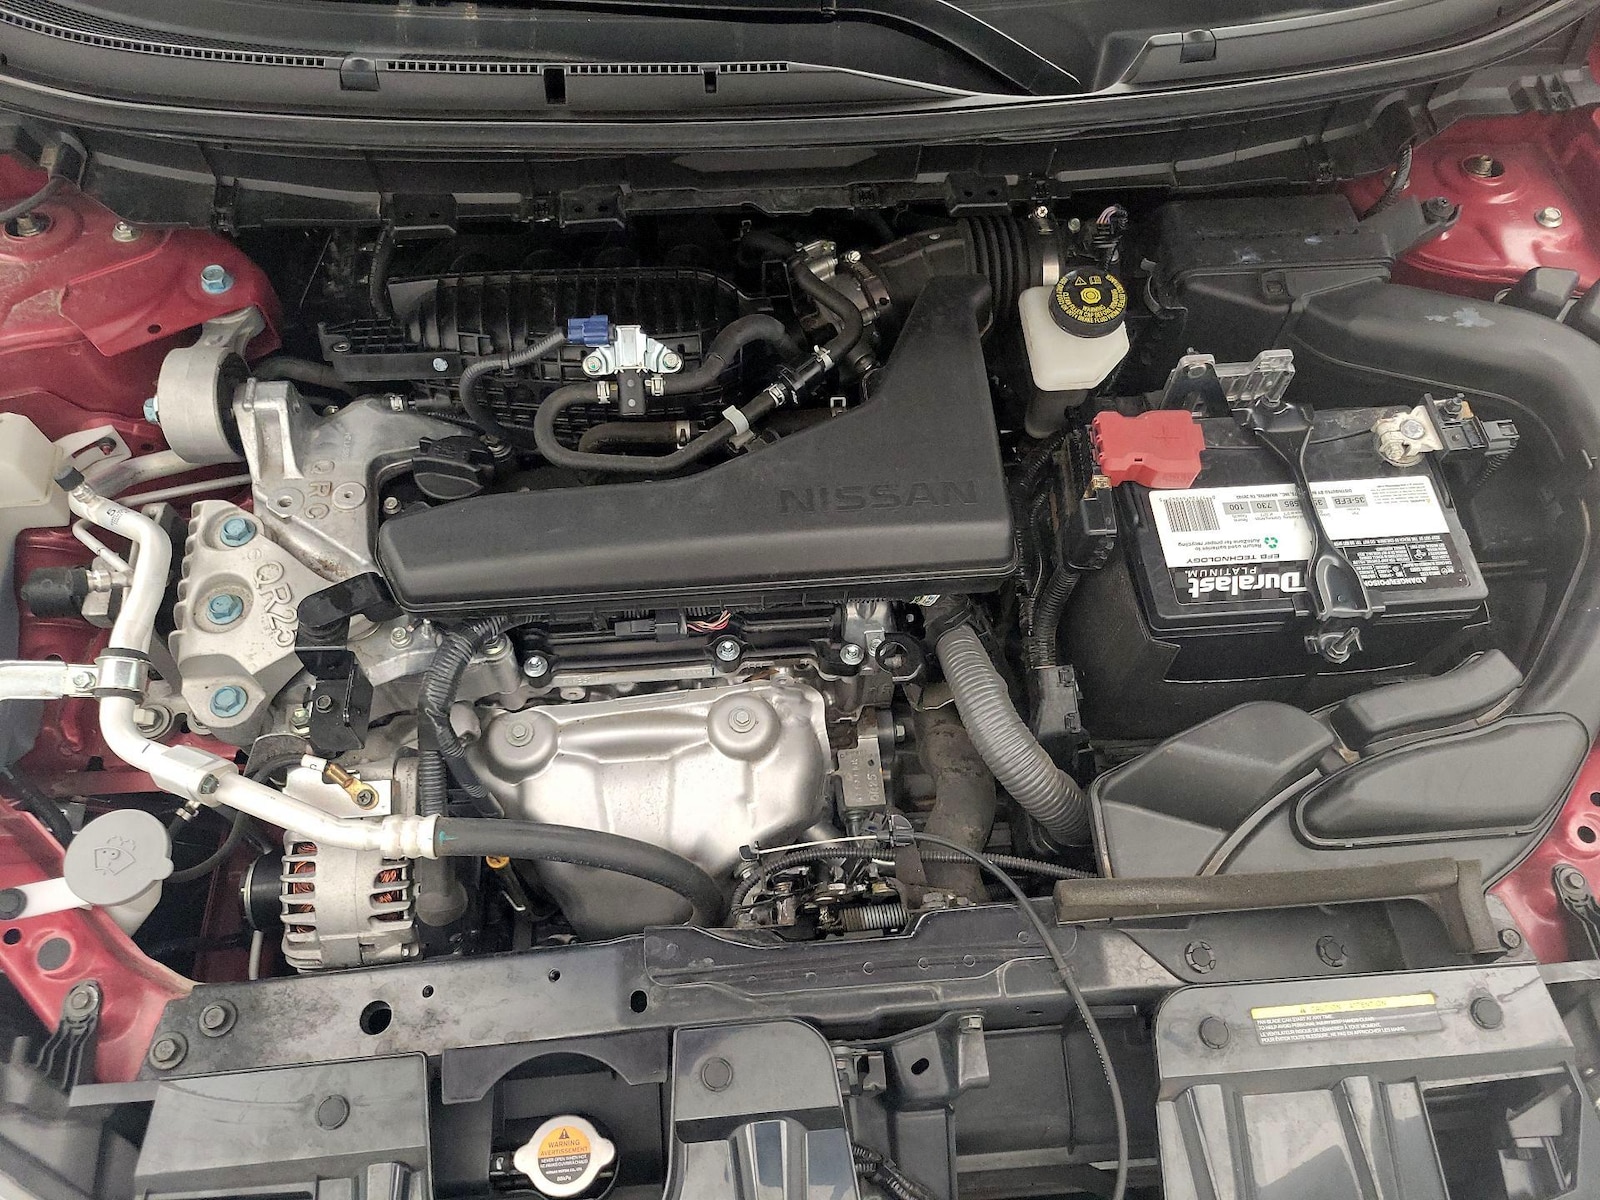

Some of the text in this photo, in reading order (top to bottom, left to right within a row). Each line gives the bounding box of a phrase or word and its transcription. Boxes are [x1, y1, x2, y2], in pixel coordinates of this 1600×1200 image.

[778, 479, 978, 514] NISSAN
[1334, 496, 1365, 505] 35-EFB
[1186, 554, 1257, 564] TECHNOLOGY
[1188, 572, 1307, 599] Duralast
[253, 561, 298, 647] QR25
[548, 1139, 580, 1148] WARNING
[540, 1146, 588, 1156] AVERTISSEMENT
